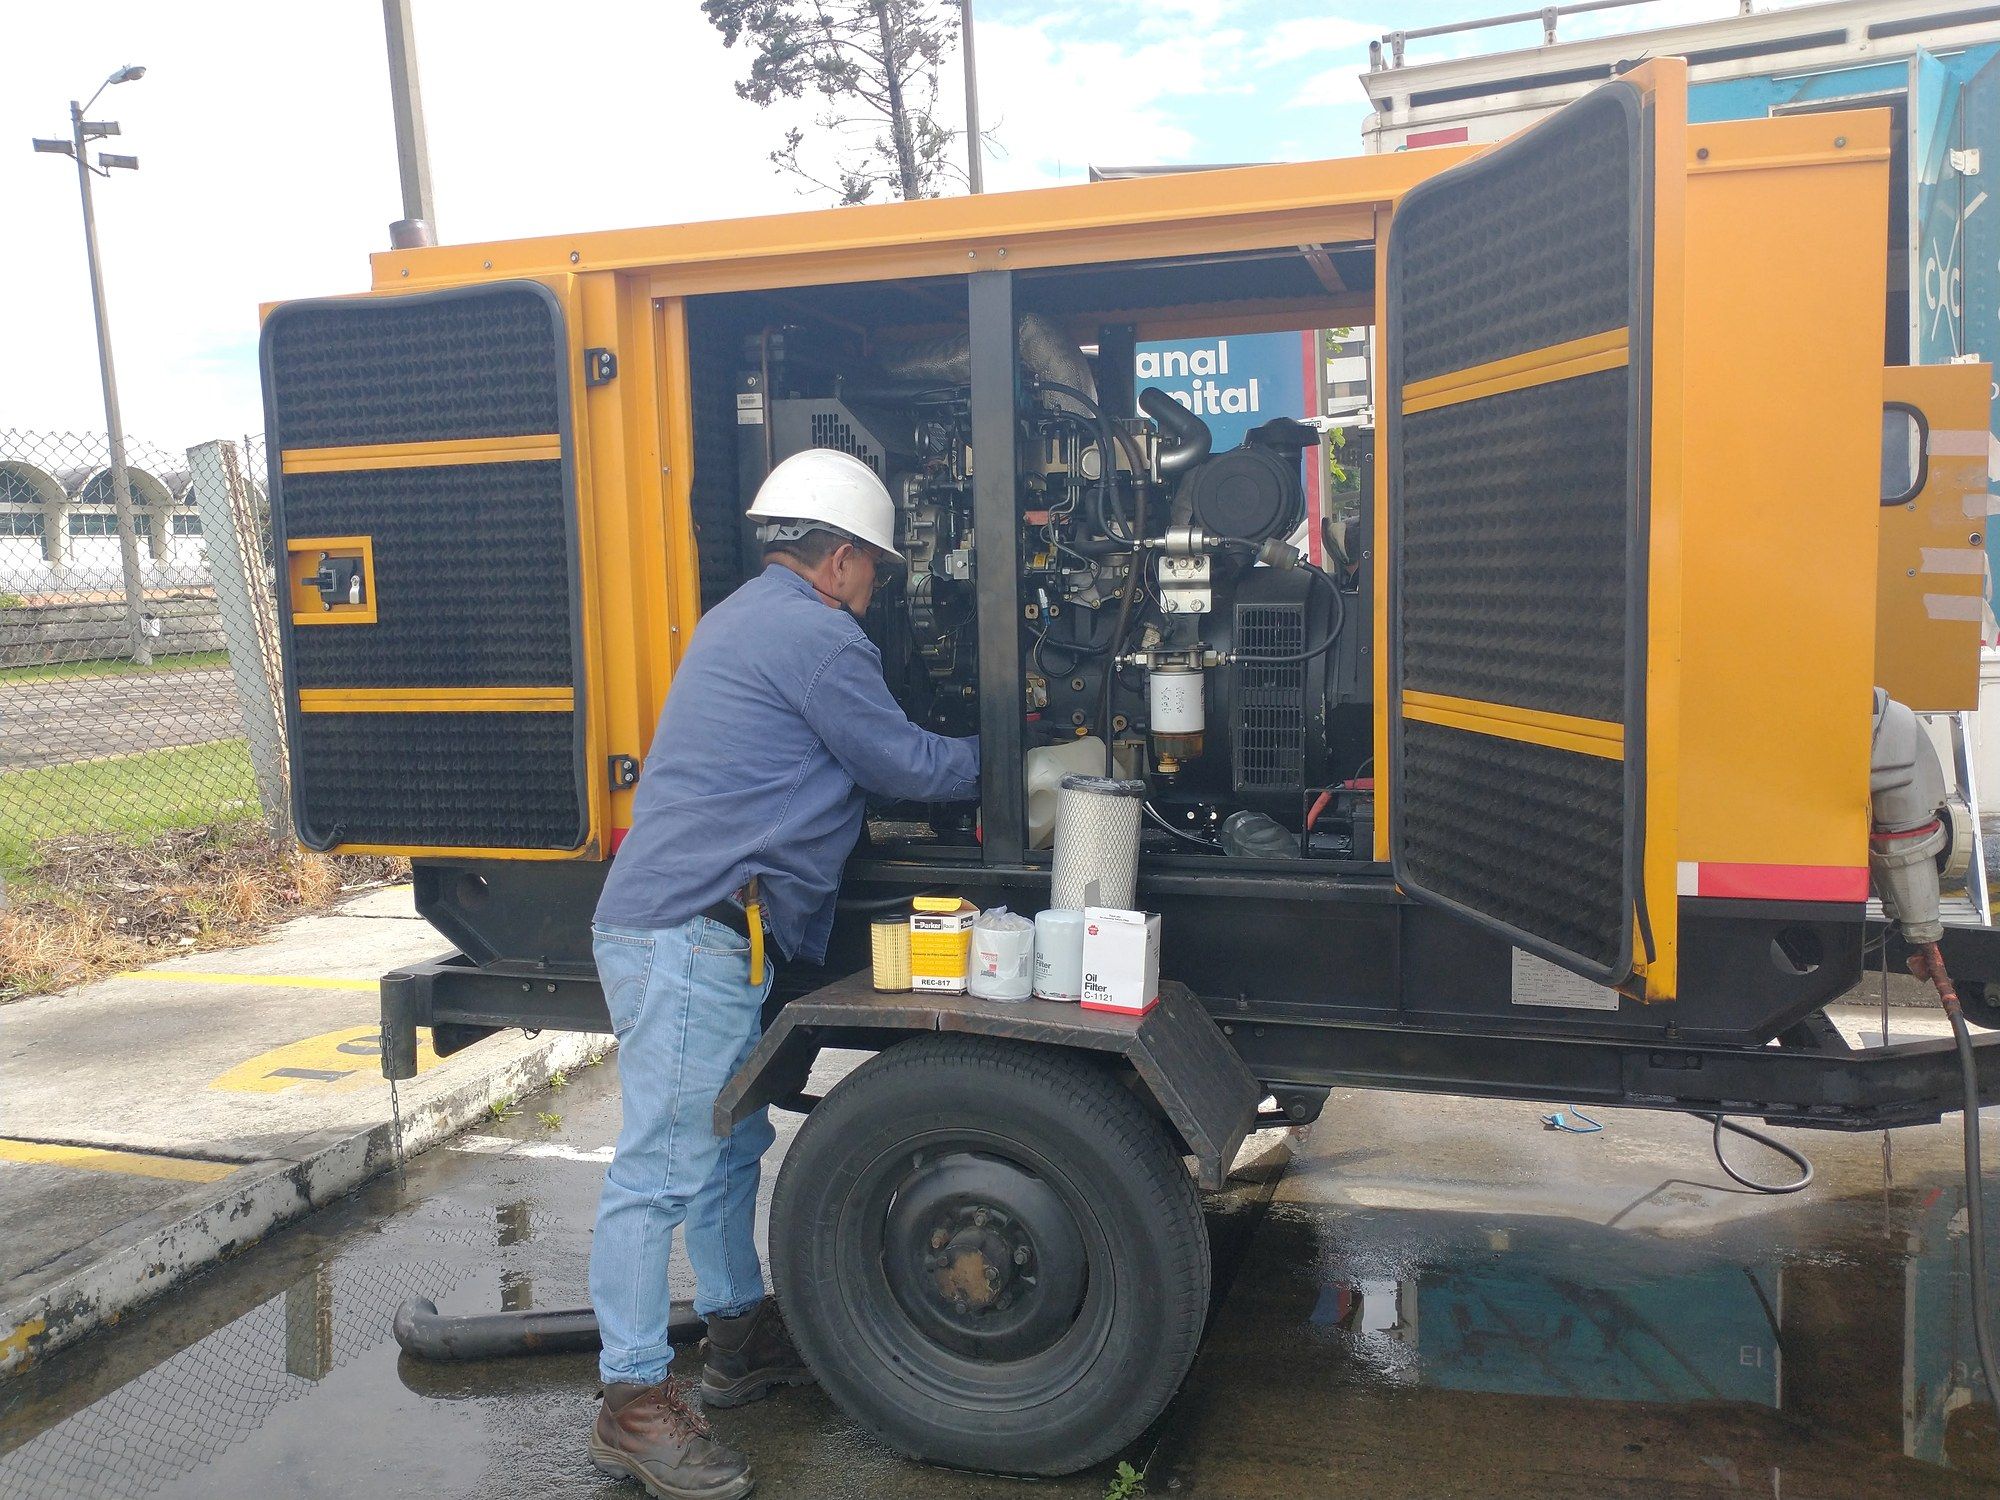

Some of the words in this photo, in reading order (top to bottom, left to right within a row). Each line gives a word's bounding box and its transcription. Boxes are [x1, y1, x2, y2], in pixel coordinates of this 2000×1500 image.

[919, 921, 941, 929] Parker
[1036, 952, 1044, 960] Oil
[1085, 973, 1098, 982] Oil
[1084, 982, 1107, 993] Filter
[1083, 992, 1113, 1002] C-1121
